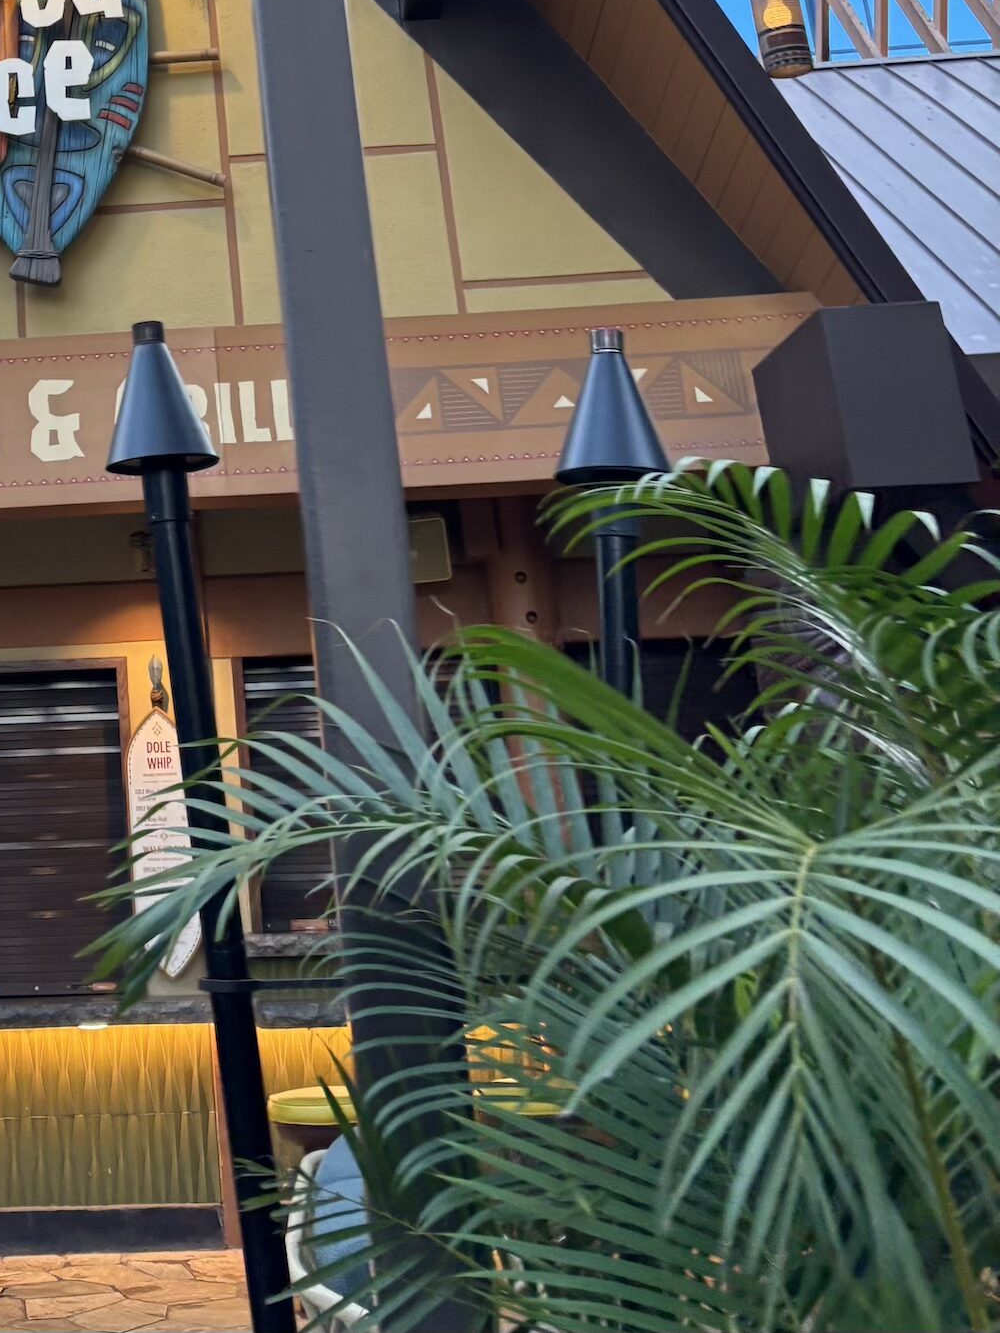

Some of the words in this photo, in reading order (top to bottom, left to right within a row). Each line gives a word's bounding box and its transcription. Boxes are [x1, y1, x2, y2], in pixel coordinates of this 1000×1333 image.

[28, 379, 86, 462] &
[114, 378, 295, 444] ILL
[146, 741, 171, 754] DOLE
